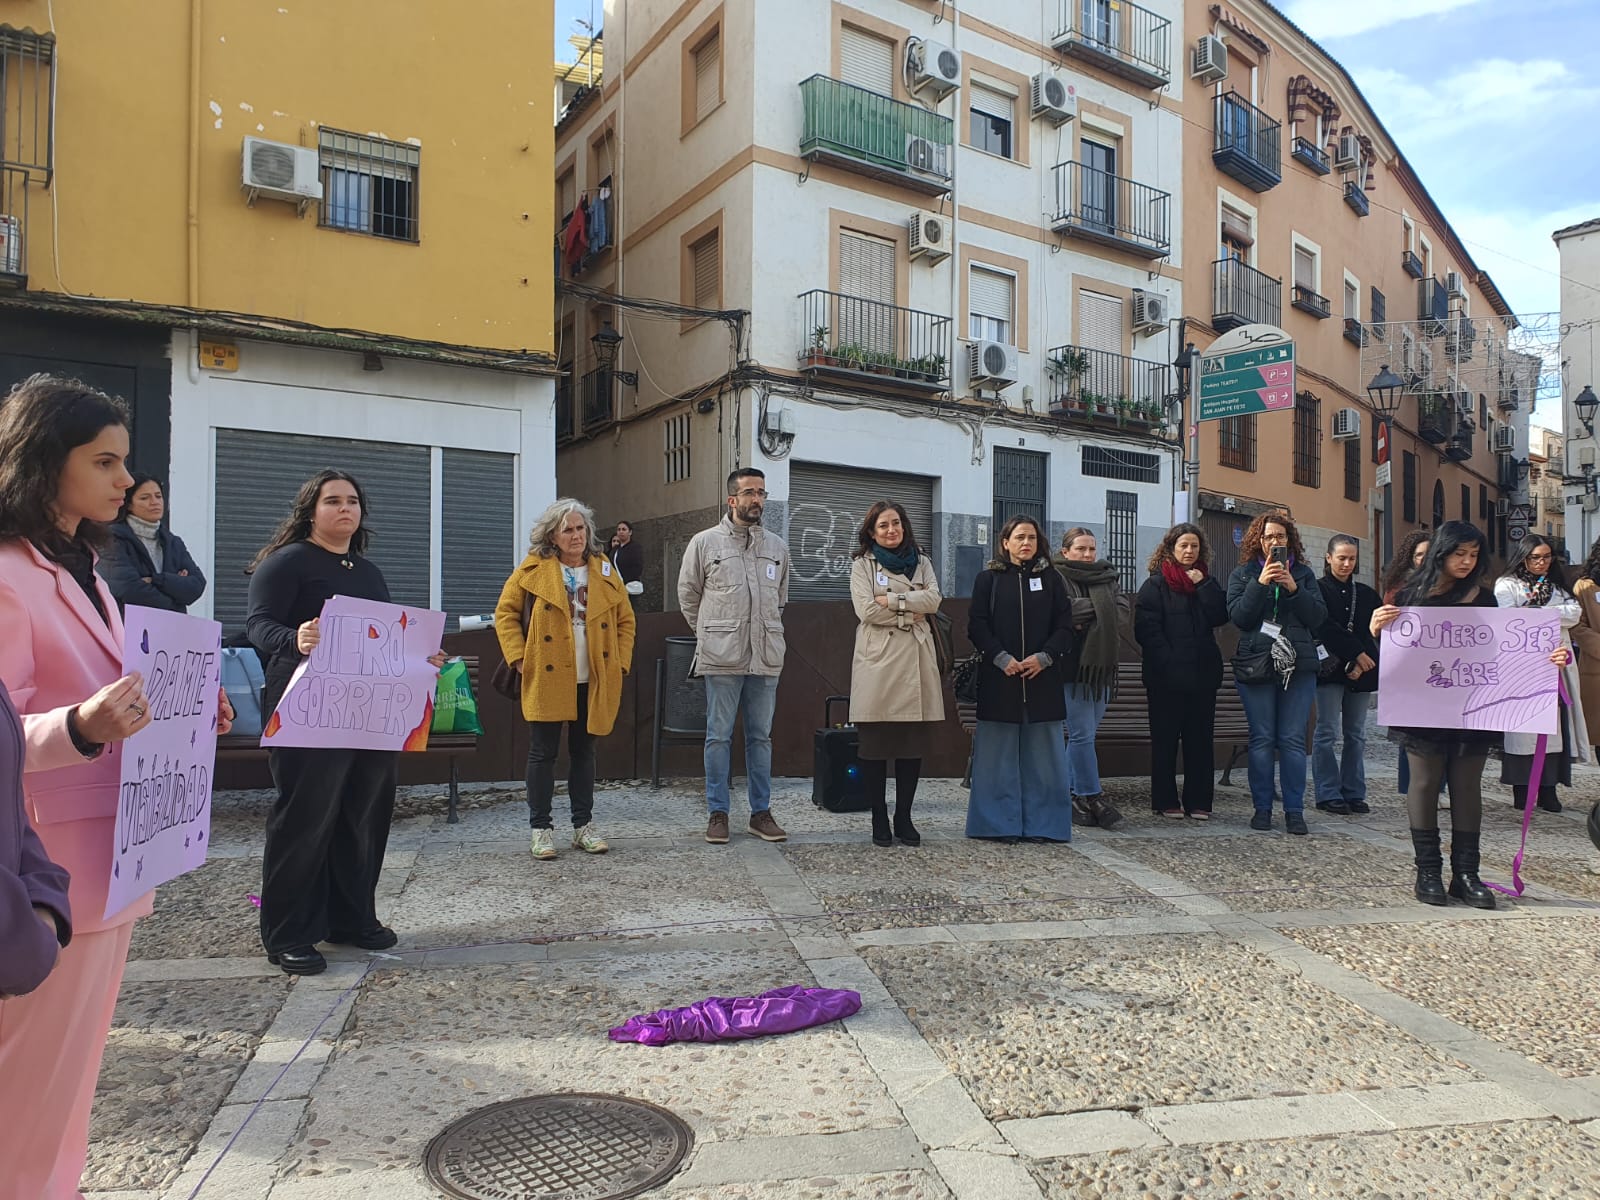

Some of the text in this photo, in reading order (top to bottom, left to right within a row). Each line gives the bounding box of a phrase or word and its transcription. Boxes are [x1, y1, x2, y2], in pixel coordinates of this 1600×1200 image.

[308, 614, 407, 677] UIERO
[146, 650, 214, 721] DAME
[288, 675, 413, 737] CORRER
[121, 763, 209, 855] VISIBILIDAD
